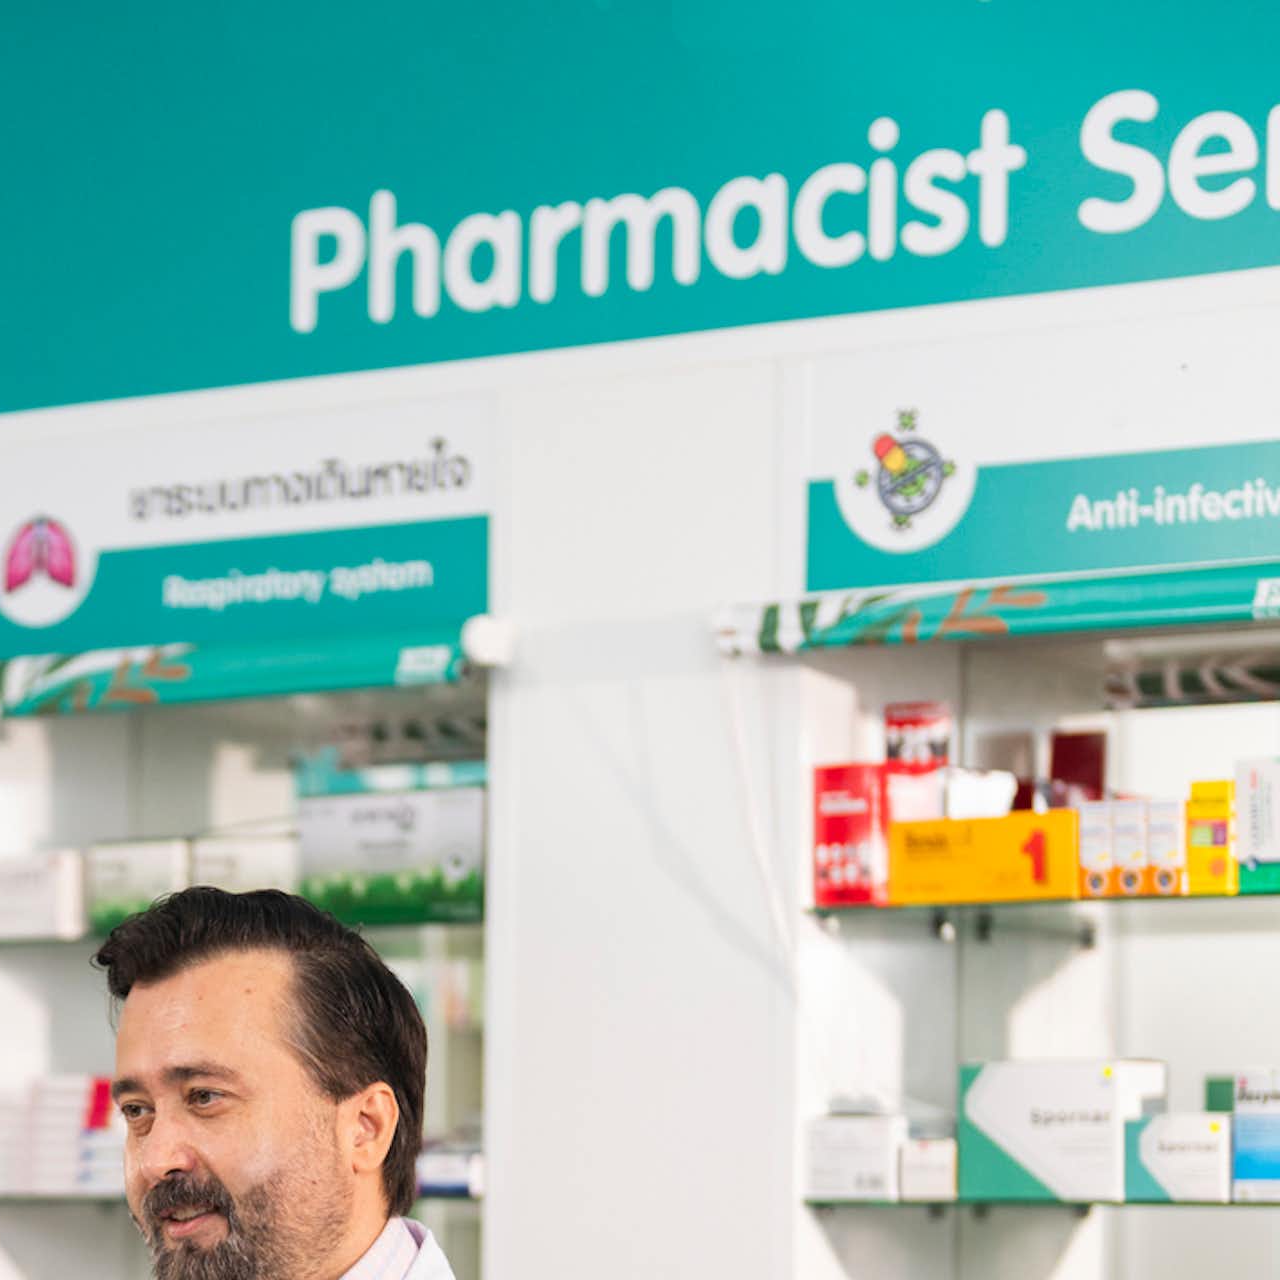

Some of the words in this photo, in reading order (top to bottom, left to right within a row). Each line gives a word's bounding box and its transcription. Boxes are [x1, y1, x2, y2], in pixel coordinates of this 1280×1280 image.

[291, 109, 1028, 334] Pharmacist
[162, 568, 325, 611] Respiratory
[329, 556, 434, 600] system
